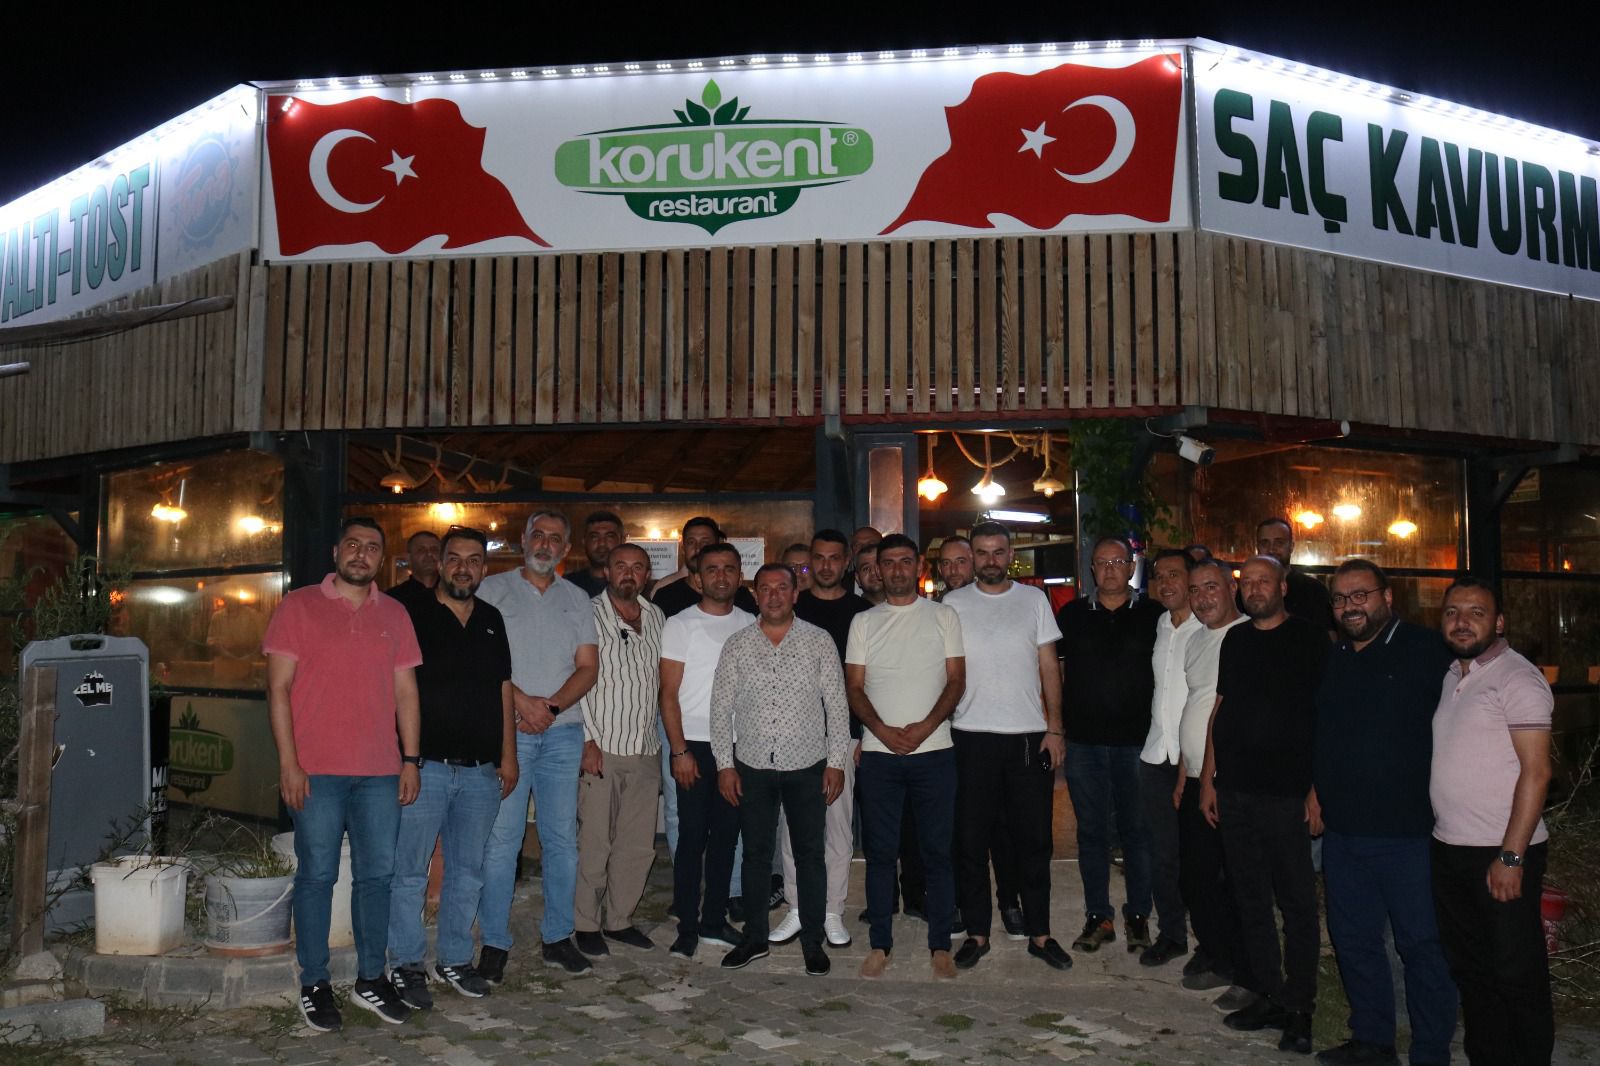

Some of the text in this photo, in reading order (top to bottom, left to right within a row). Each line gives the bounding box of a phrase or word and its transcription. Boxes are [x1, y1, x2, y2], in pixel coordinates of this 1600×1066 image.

[588, 127, 838, 184] korukent
[1213, 87, 1600, 272] SAÇ KAVURM
[648, 190, 778, 218] restaurant
